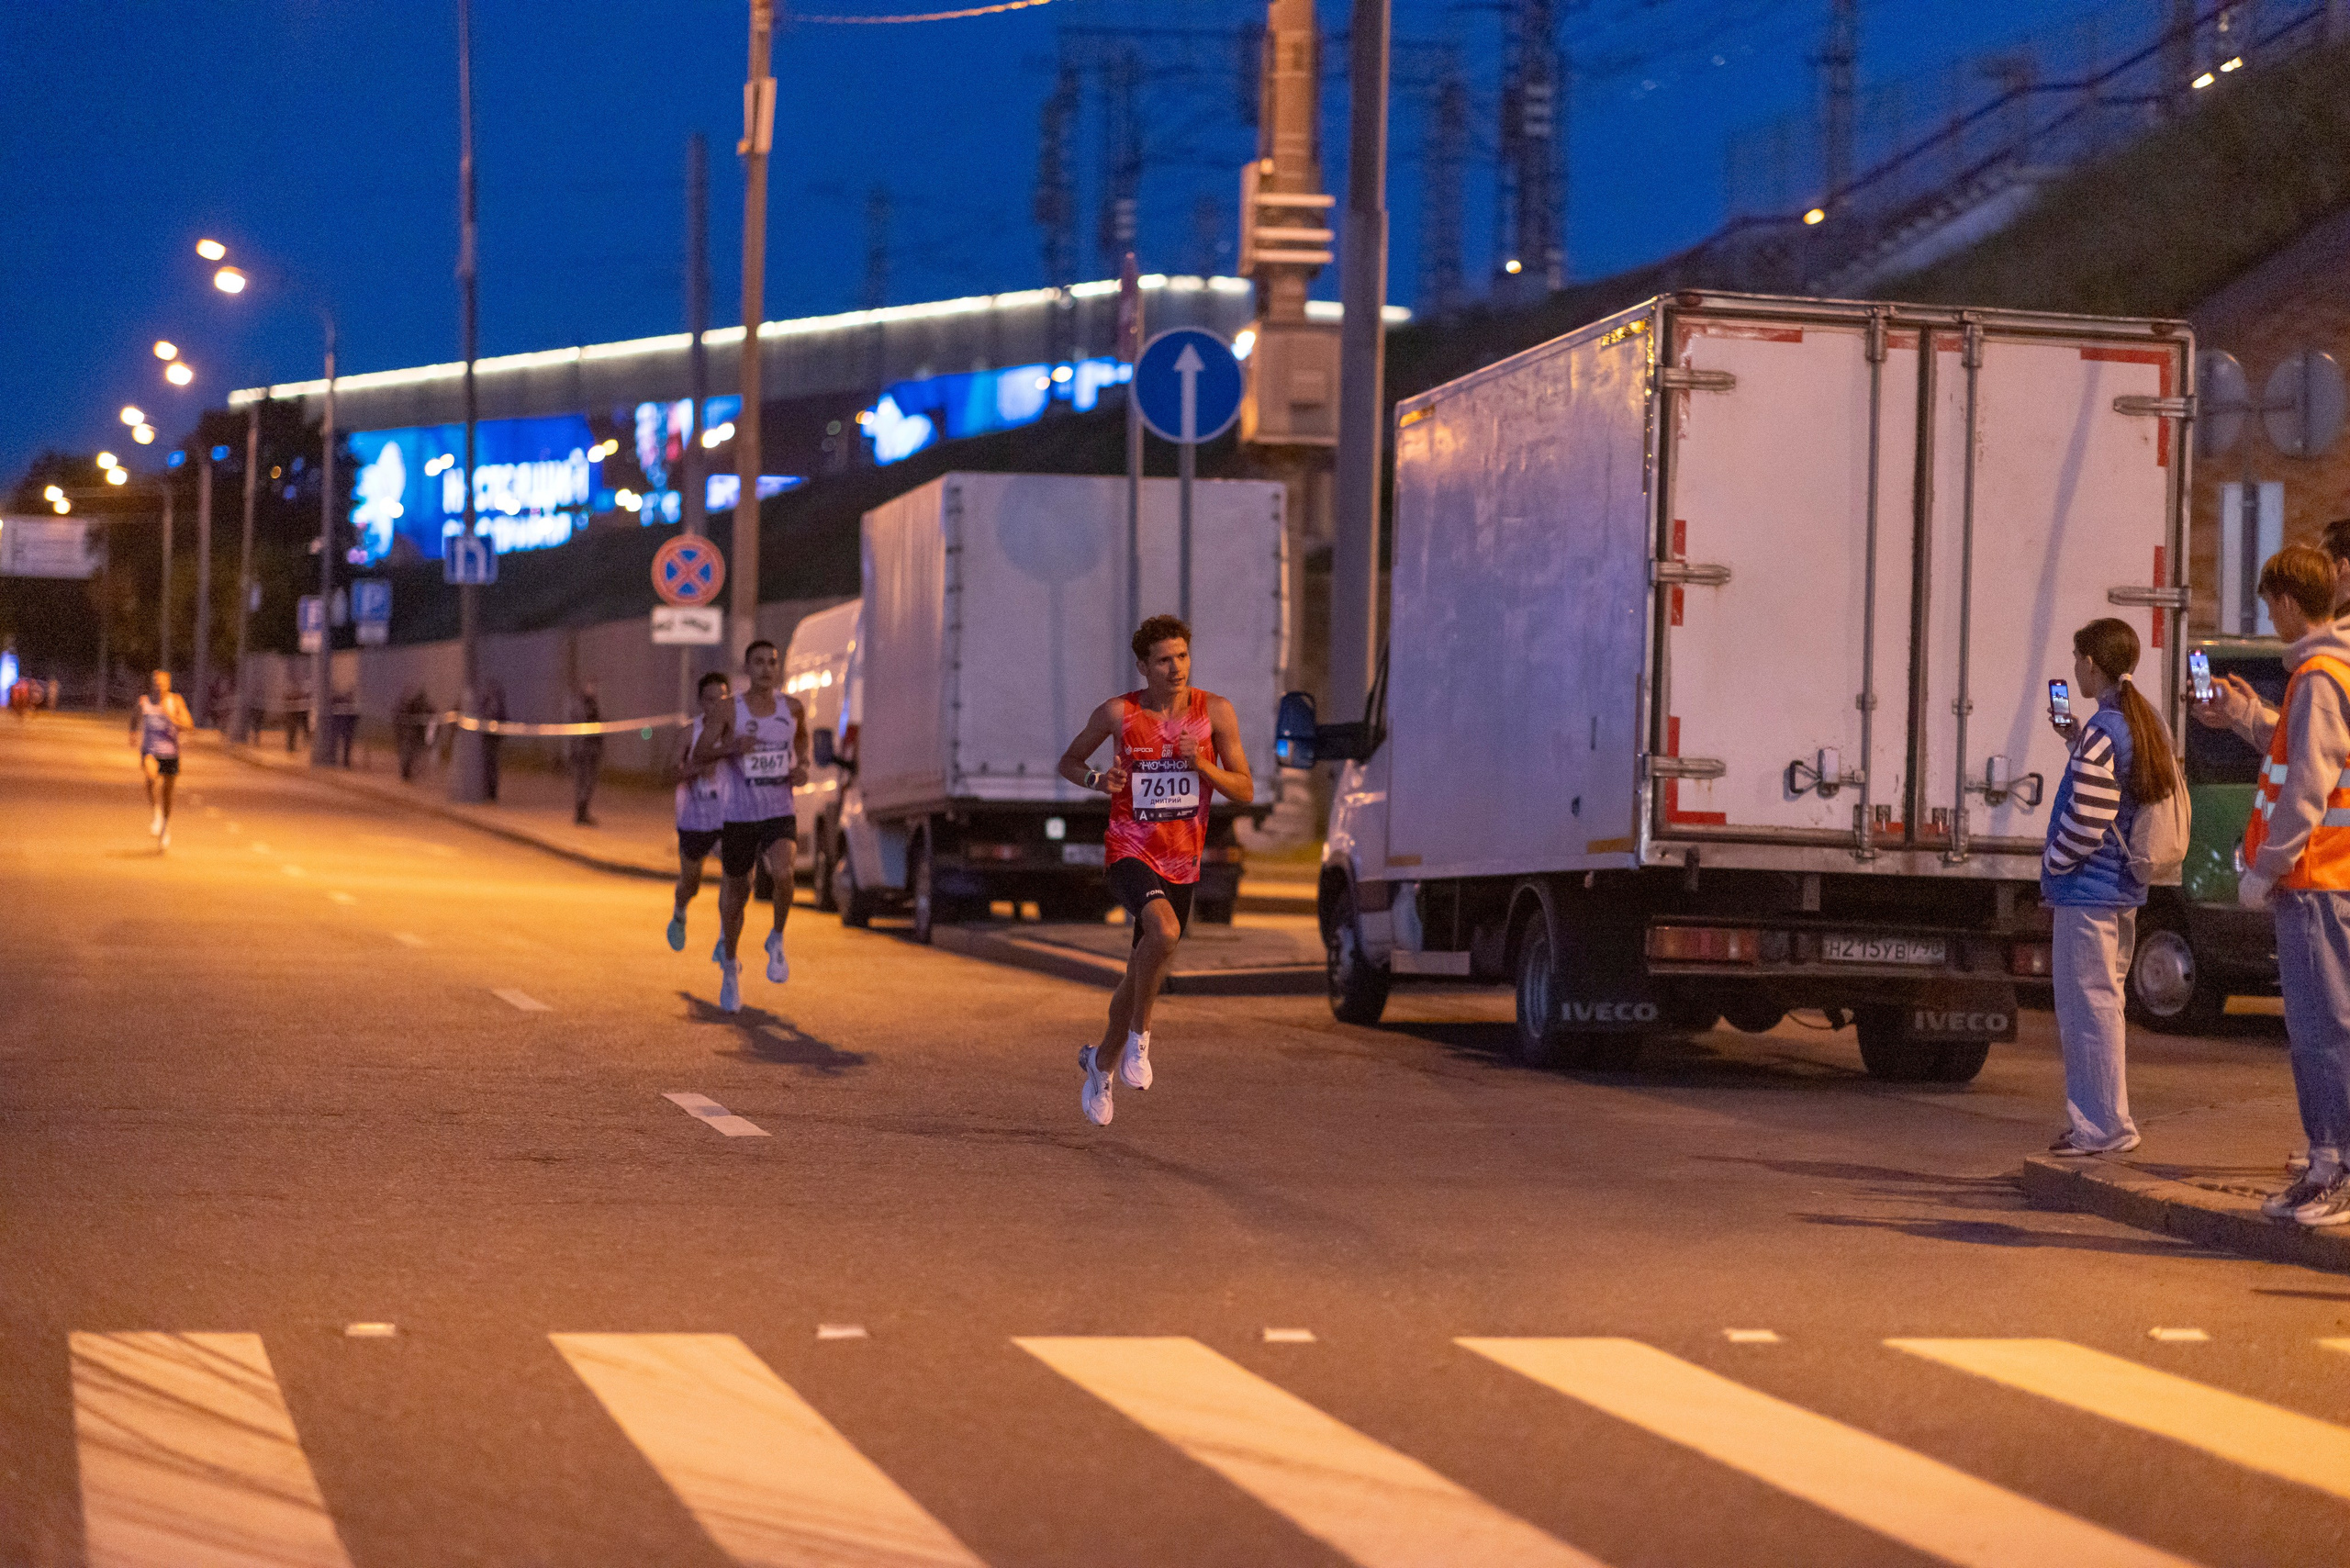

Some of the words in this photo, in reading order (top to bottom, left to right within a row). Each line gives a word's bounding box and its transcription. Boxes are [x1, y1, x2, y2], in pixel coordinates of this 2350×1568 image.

[1140, 778, 1191, 797] 7610
[1149, 796, 1181, 805] ДМИТРИЙ
[1561, 1002, 1658, 1022] IVECO
[1913, 1011, 2009, 1032] IVECO
